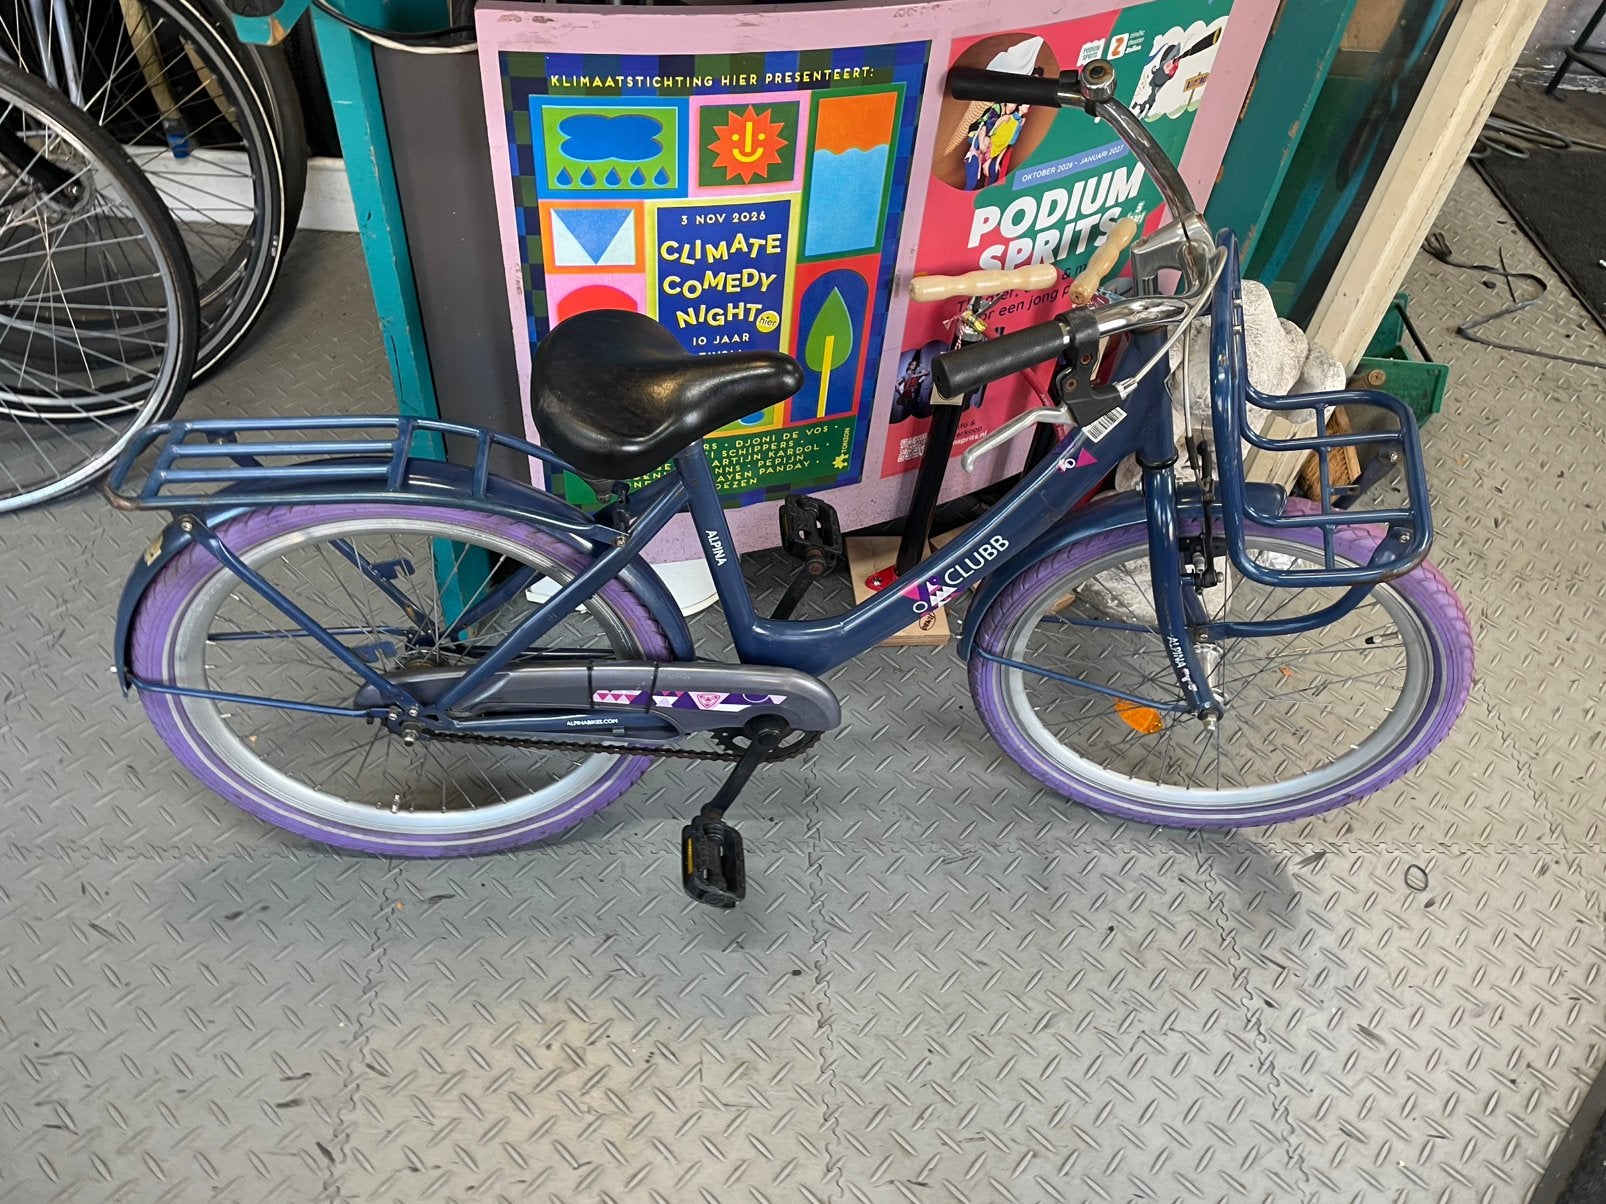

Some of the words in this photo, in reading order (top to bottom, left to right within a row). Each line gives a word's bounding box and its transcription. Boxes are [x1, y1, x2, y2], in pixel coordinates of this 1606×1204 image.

[550, 75, 713, 88] KLIMAATSTICHTING
[721, 74, 758, 86] HIER
[765, 66, 874, 85] PRESENTEERT:
[1022, 167, 1056, 182] OKTOBER
[1057, 161, 1073, 173] 2026
[1080, 150, 1108, 165] JANUARI
[1108, 145, 1124, 156] 2027
[968, 161, 1146, 249] PODIUM
[681, 215, 688, 225] 3
[696, 213, 726, 225] NOV
[732, 211, 766, 222] 2026
[660, 233, 782, 265] CLIMATE
[979, 207, 1122, 270] SPRITS
[663, 268, 777, 299] COMEDY
[998, 301, 1025, 317] een
[1027, 289, 1059, 311] jong
[676, 302, 762, 329] NIGHT
[758, 315, 776, 327] hier
[713, 333, 750, 345] JAAR
[735, 434, 776, 448] DJONI
[783, 431, 799, 440] DE
[806, 425, 828, 436] VOS
[841, 427, 851, 453] TONZON
[956, 425, 983, 438] erkoop
[712, 453, 761, 467] ARTIJN
[768, 444, 820, 458] KARDOL
[722, 440, 794, 458] SCHIPPERS
[714, 465, 741, 475] NNS
[757, 454, 804, 468] PEPIJN
[716, 470, 752, 482] AYEN
[759, 460, 810, 476] PANDAY
[716, 477, 758, 490] OEZEN
[705, 530, 728, 566] ALPINA
[944, 535, 1010, 585] CLUBB
[1167, 634, 1187, 669] ALPINA
[566, 718, 619, 727] ALPINABIKES.COM
